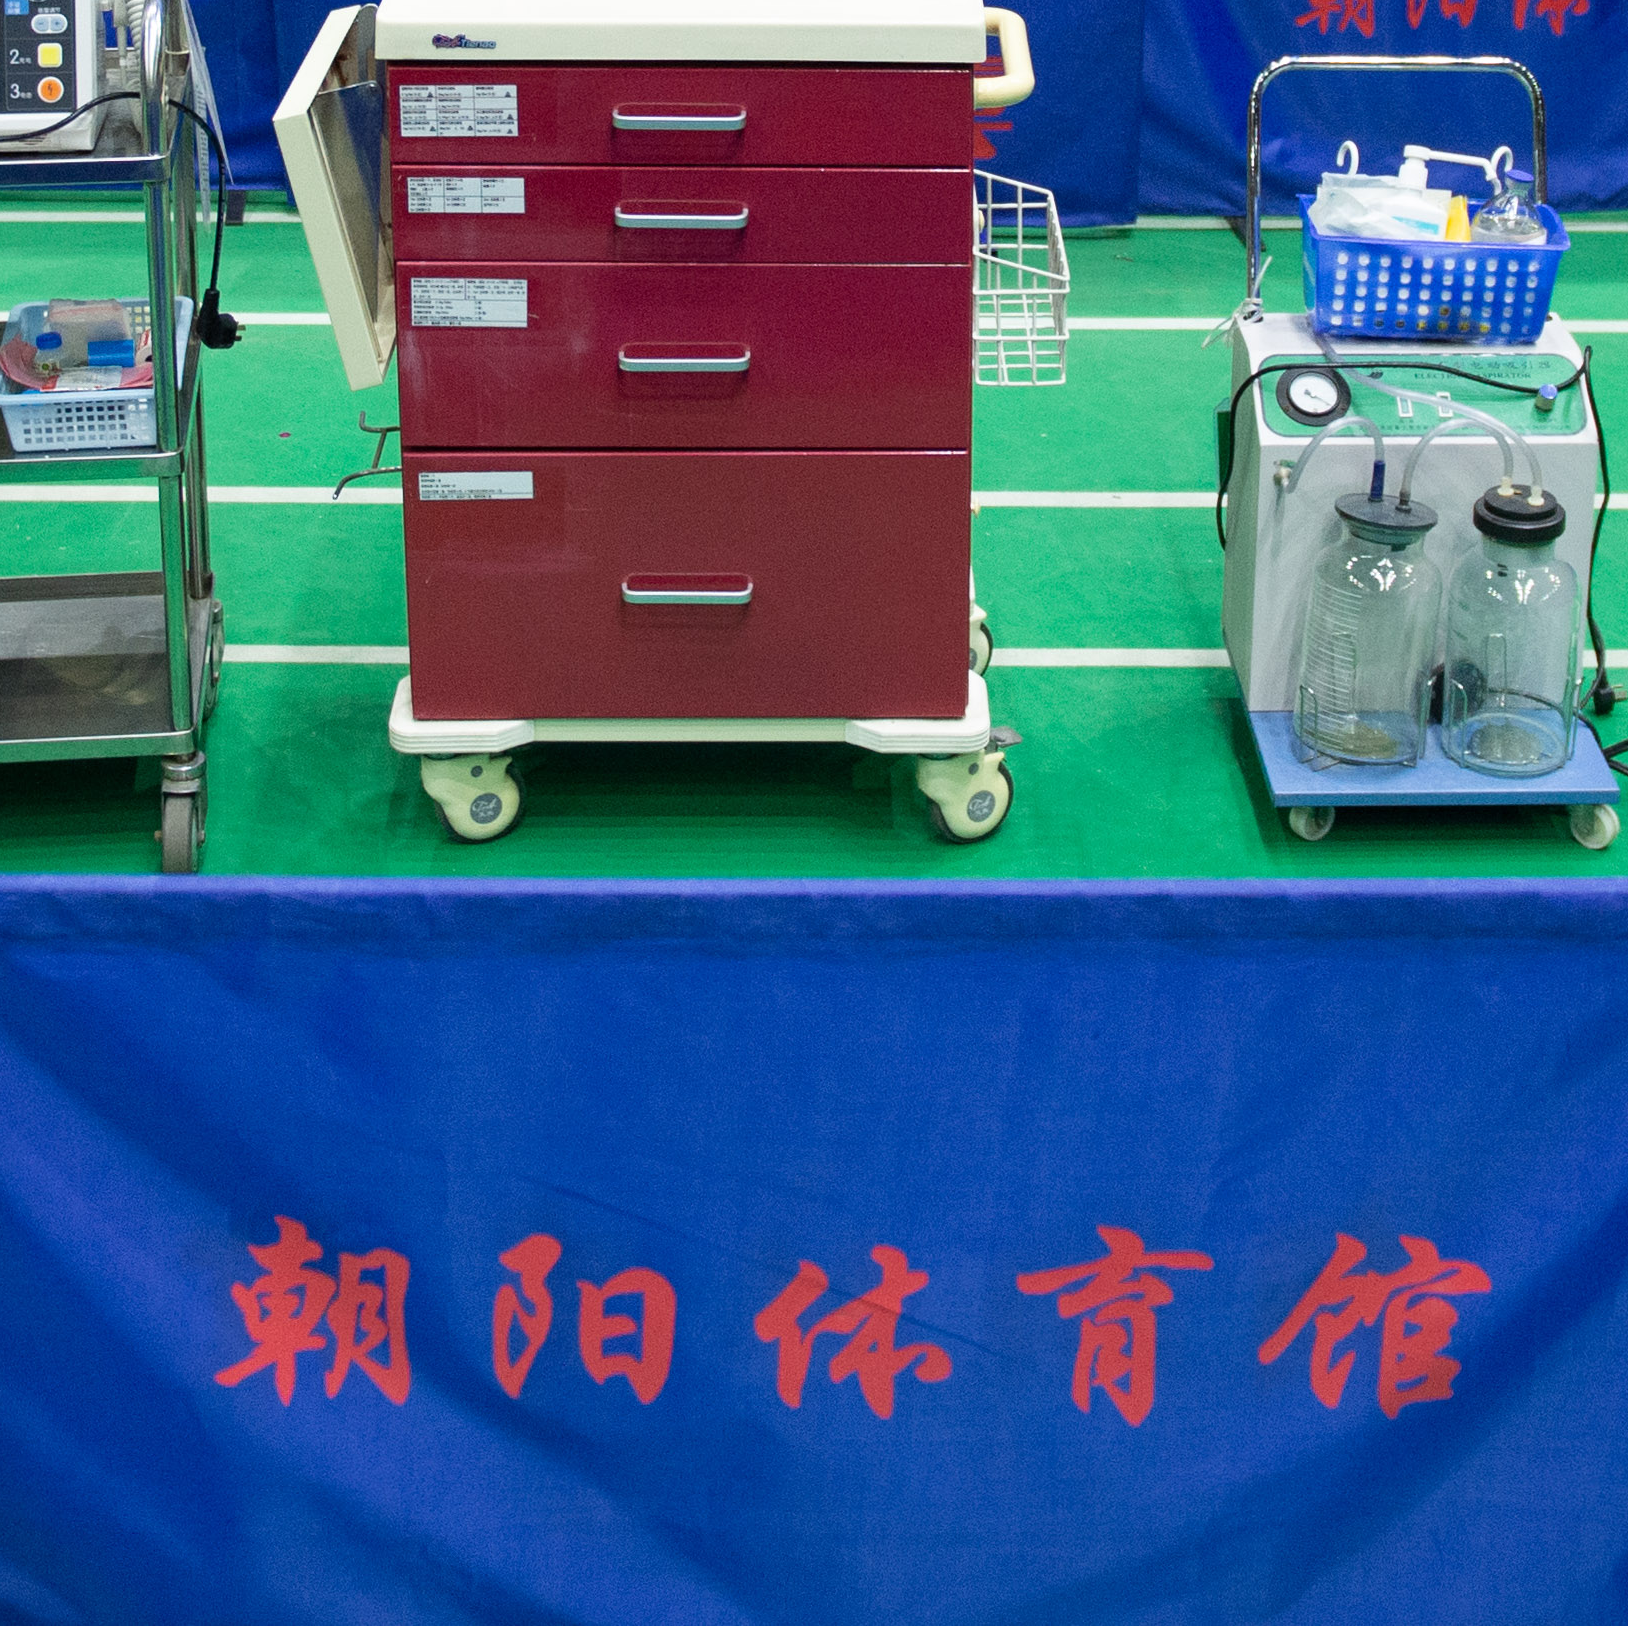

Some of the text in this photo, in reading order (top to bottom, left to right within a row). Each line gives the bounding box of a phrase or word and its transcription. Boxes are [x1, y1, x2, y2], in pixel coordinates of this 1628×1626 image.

[9, 49, 19, 64] 2
[9, 84, 20, 99] 3
[213, 1214, 1493, 1428] 朝阳体育馆
